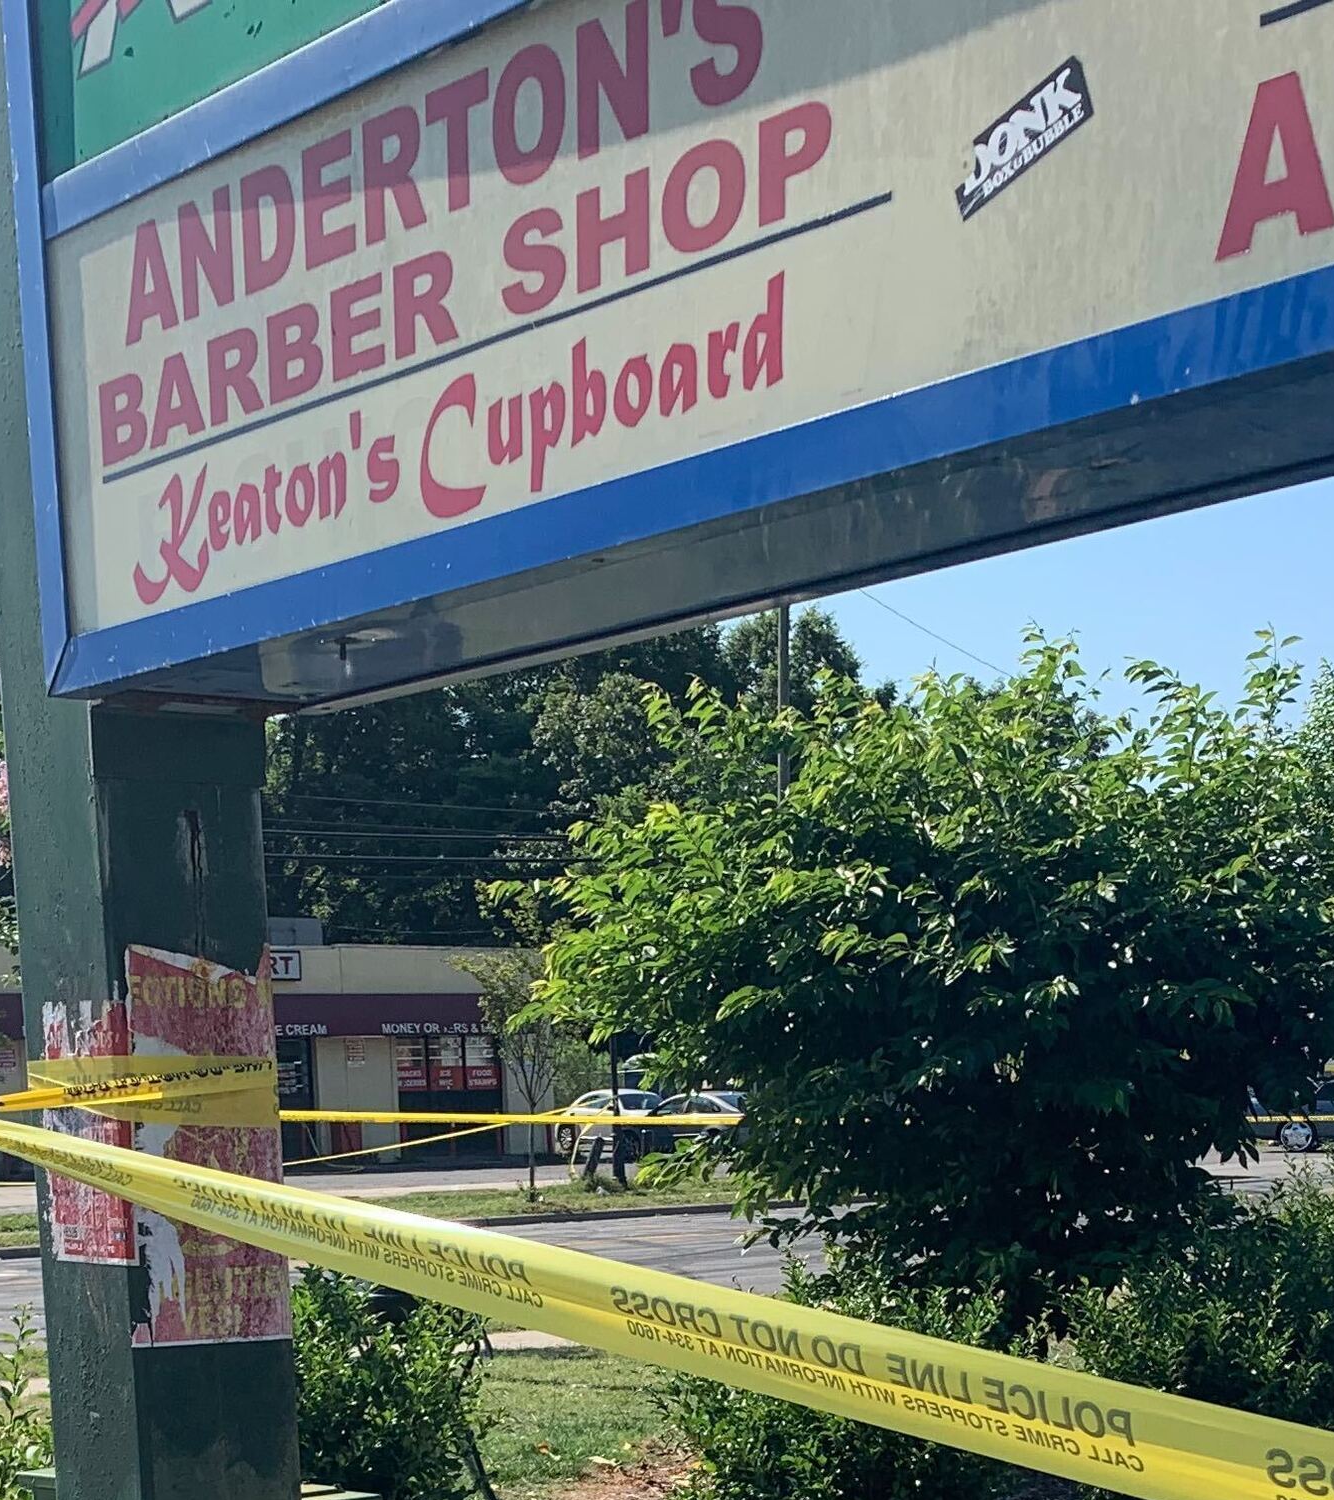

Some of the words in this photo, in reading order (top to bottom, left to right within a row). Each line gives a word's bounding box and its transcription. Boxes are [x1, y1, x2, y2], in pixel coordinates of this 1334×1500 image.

[98, 251, 458, 467] BARBER
[502, 101, 832, 315] SHOP
[125, 0, 763, 346] ANDERTON'S
[133, 411, 401, 606] Keaton's
[420, 269, 785, 518] Cupboard
[286, 1023, 327, 1036] CREAM
[381, 1022, 421, 1034] MONEY
